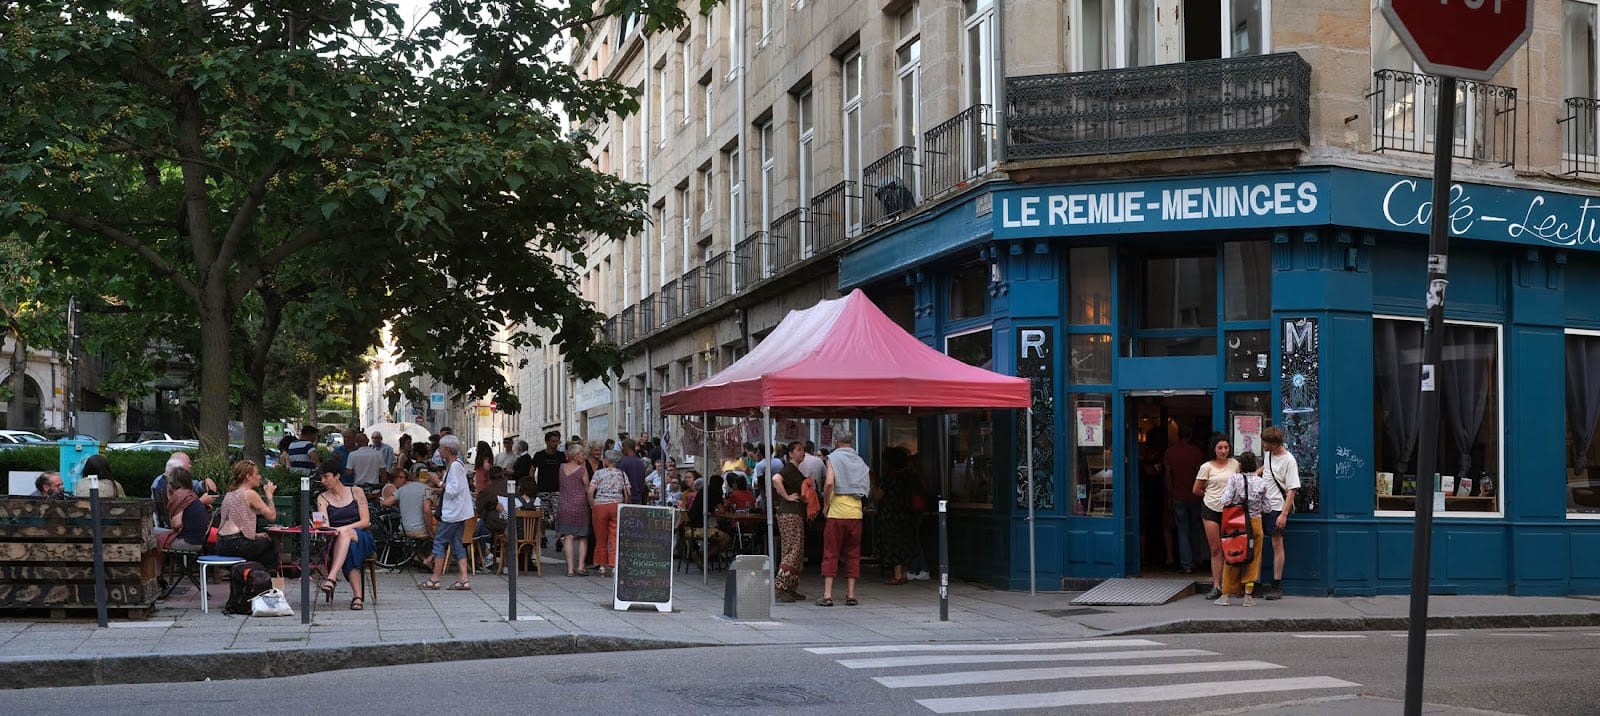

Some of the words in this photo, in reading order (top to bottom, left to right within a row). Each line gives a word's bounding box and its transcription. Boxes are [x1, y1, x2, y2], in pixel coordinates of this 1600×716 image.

[1002, 196, 1041, 228] LE
[1048, 181, 1318, 226] REMUE-MENINGES
[1021, 329, 1046, 359] R
[1285, 321, 1313, 352] M
